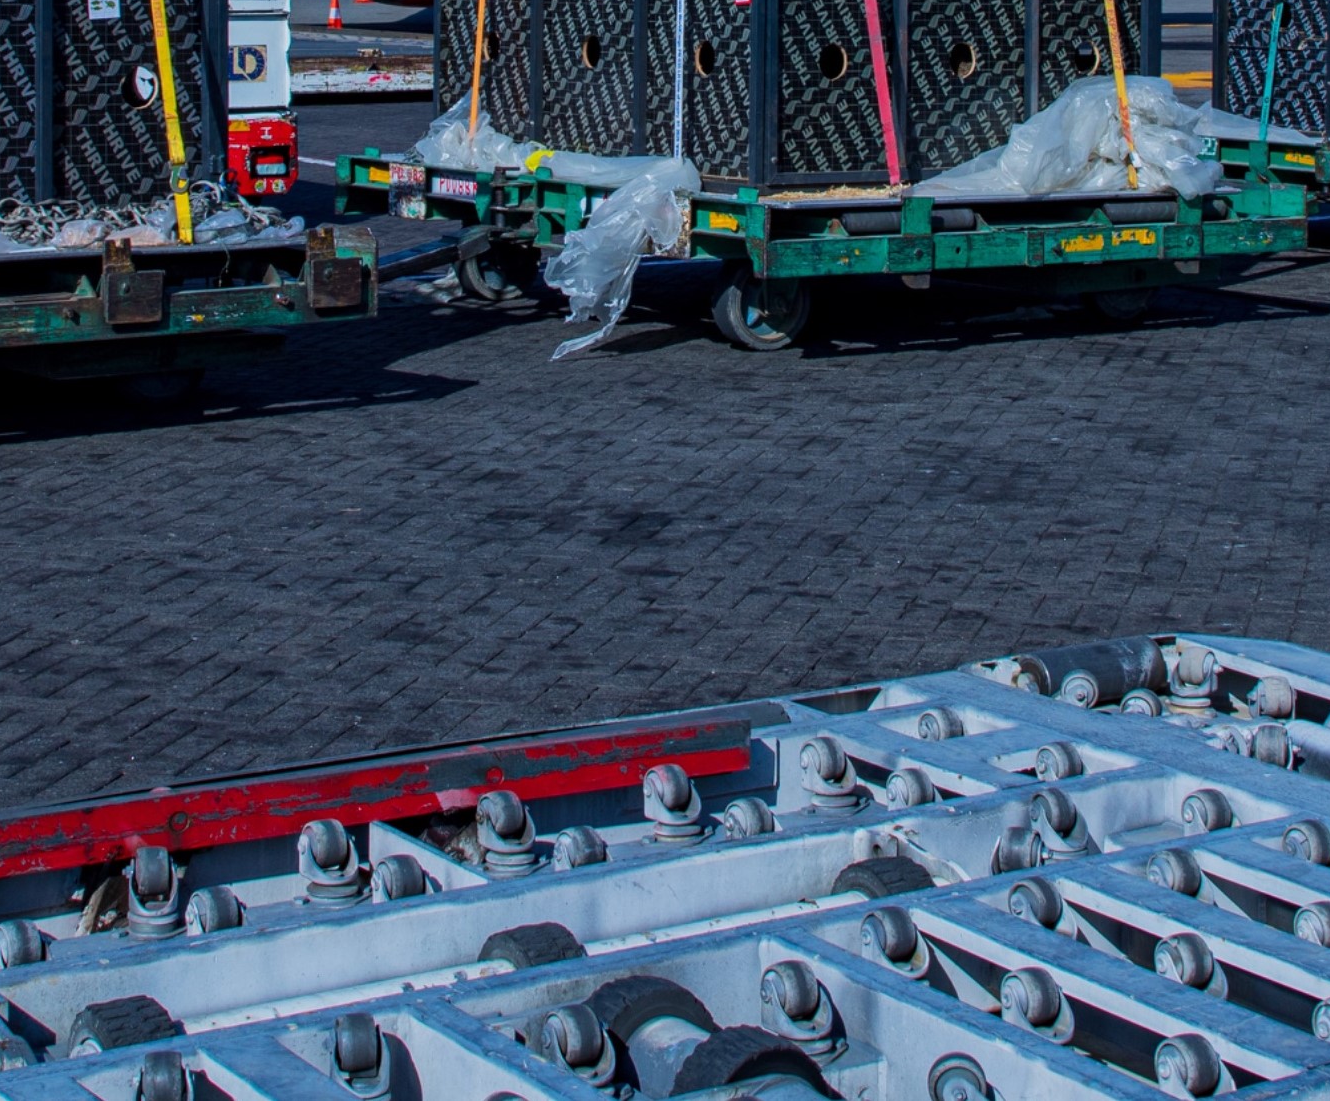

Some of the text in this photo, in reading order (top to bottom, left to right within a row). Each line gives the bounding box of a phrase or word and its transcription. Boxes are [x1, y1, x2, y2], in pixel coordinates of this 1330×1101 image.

[553, 13, 573, 71] THRIVE
[782, 23, 811, 86] THRIVE
[970, 0, 1001, 58] THRIVE
[610, 62, 630, 122] THRIVE
[921, 35, 952, 96] THRIVE
[587, 86, 607, 144] THRIVE
[598, 74, 619, 133] THRIVE
[694, 92, 716, 154] THRIVE
[706, 80, 730, 142] THRIVE
[719, 68, 742, 131] THRIVE
[836, 99, 869, 161] THRIVE
[854, 87, 884, 148] THRIVE
[75, 127, 119, 200] THRIVE
[98, 111, 141, 184] THRIVE
[802, 125, 831, 172] HRIVE
[819, 112, 853, 172] THRIVE
